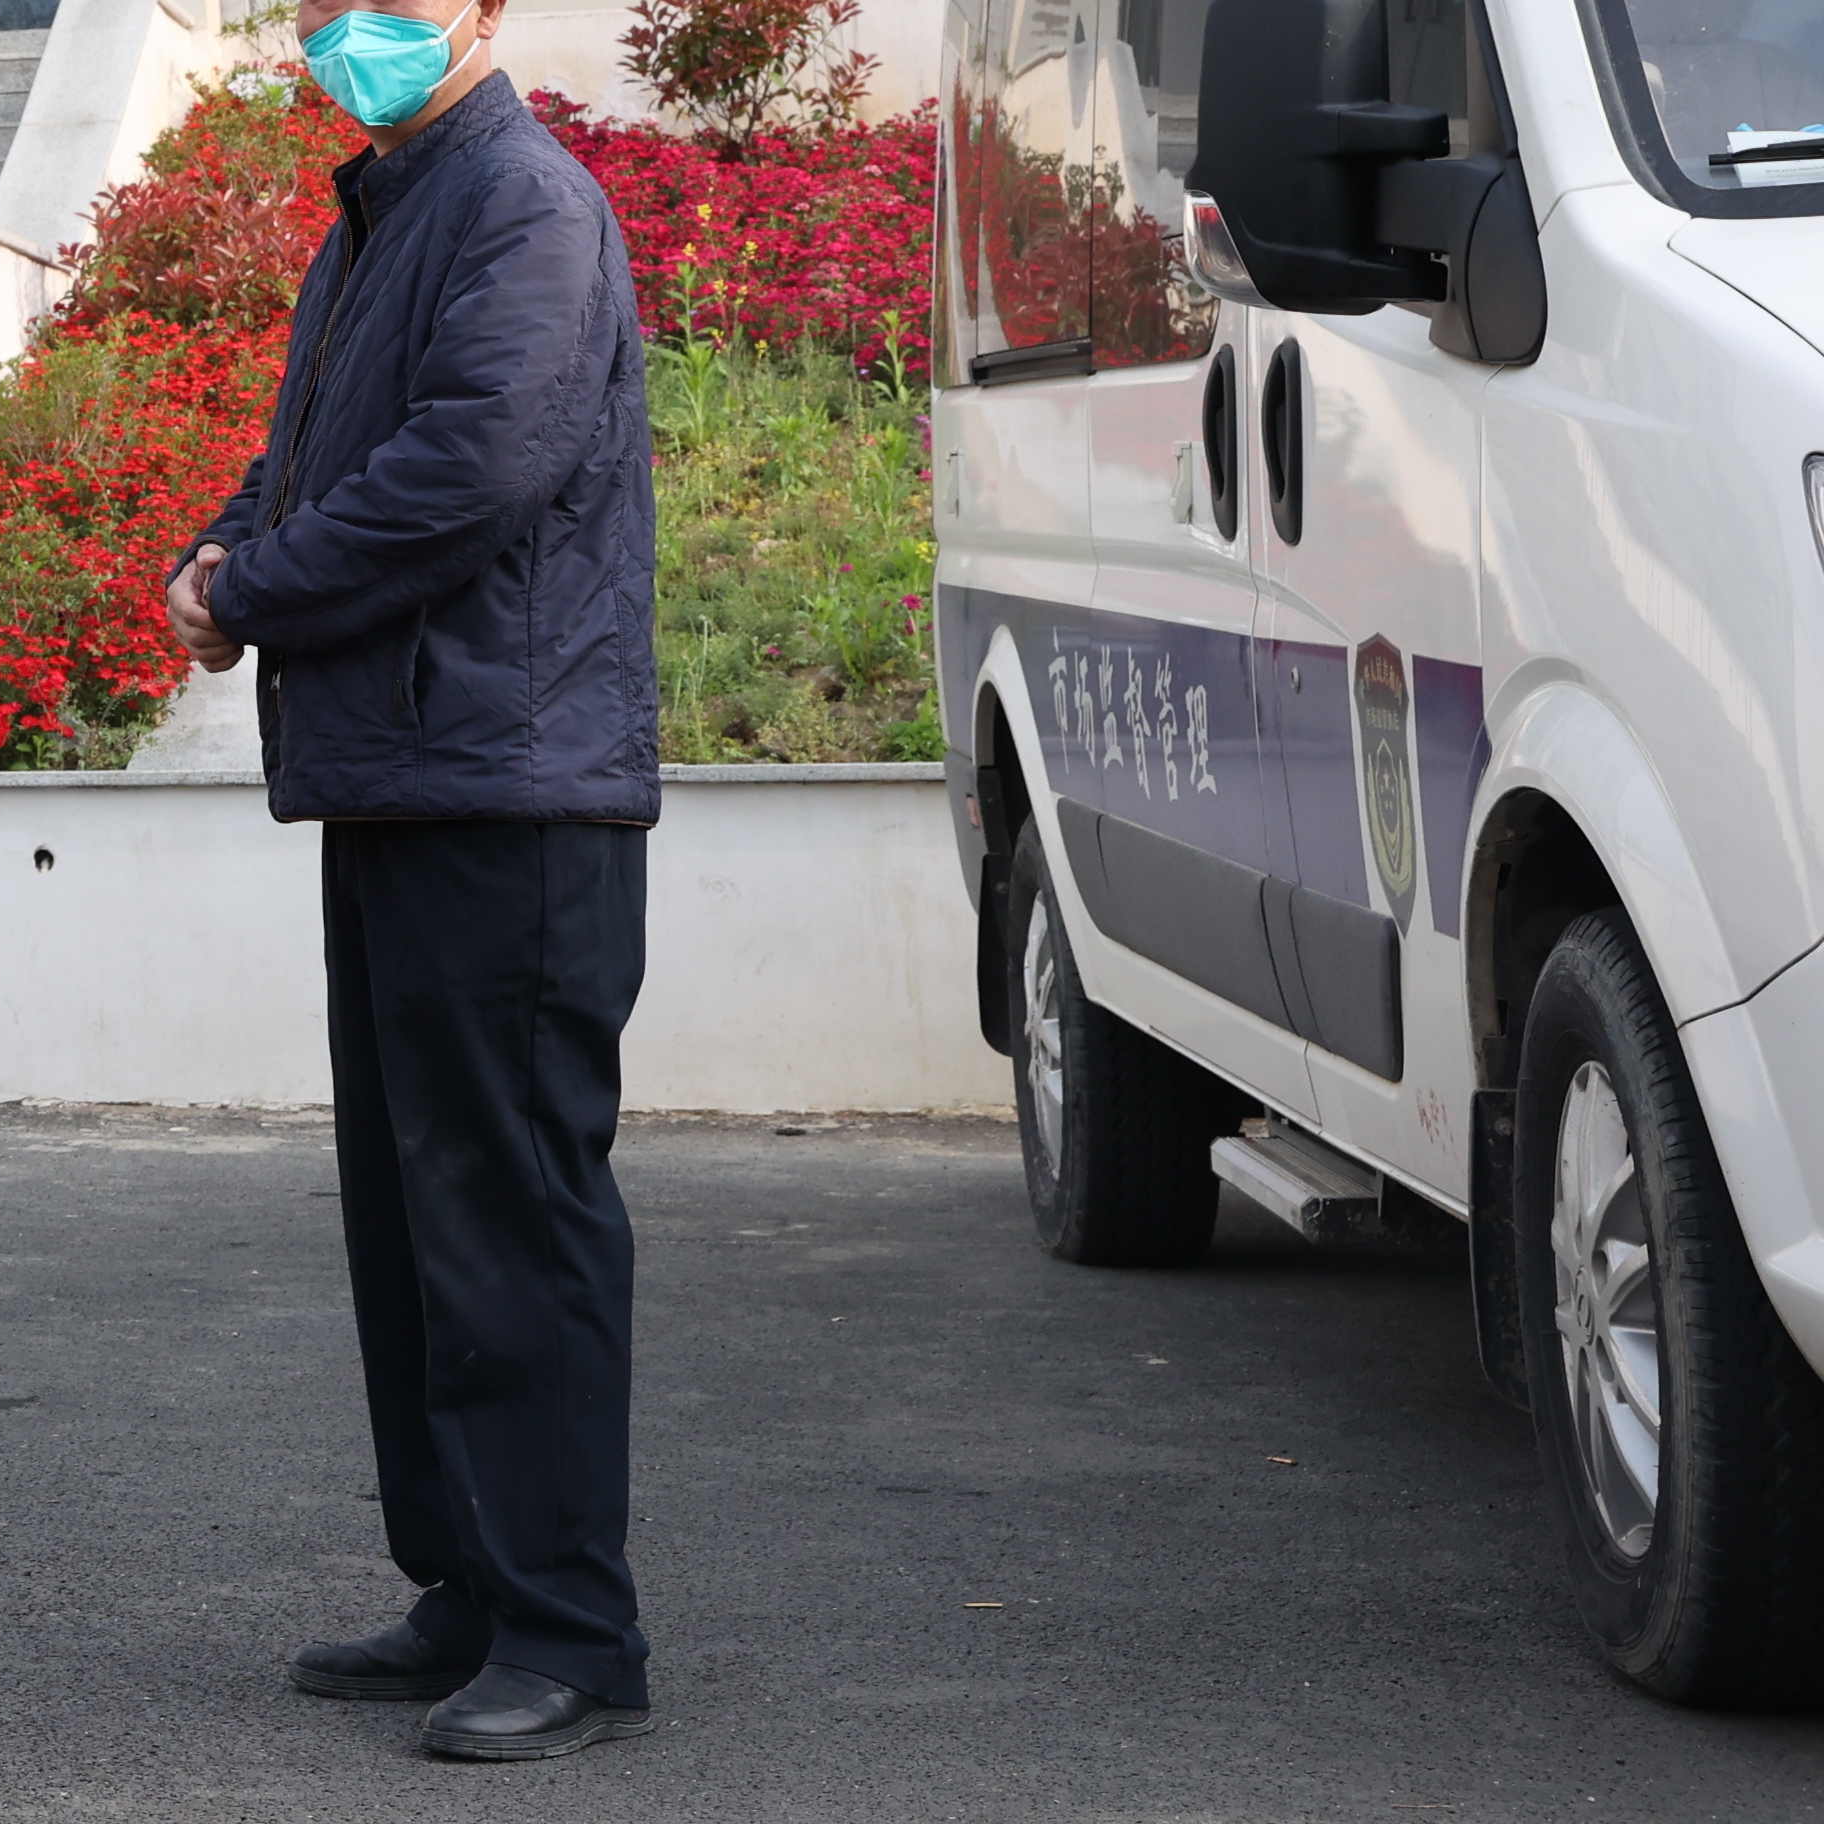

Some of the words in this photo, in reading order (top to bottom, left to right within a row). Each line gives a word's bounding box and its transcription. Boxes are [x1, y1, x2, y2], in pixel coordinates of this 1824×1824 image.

[1048, 627, 1218, 803] 市场监督管理
